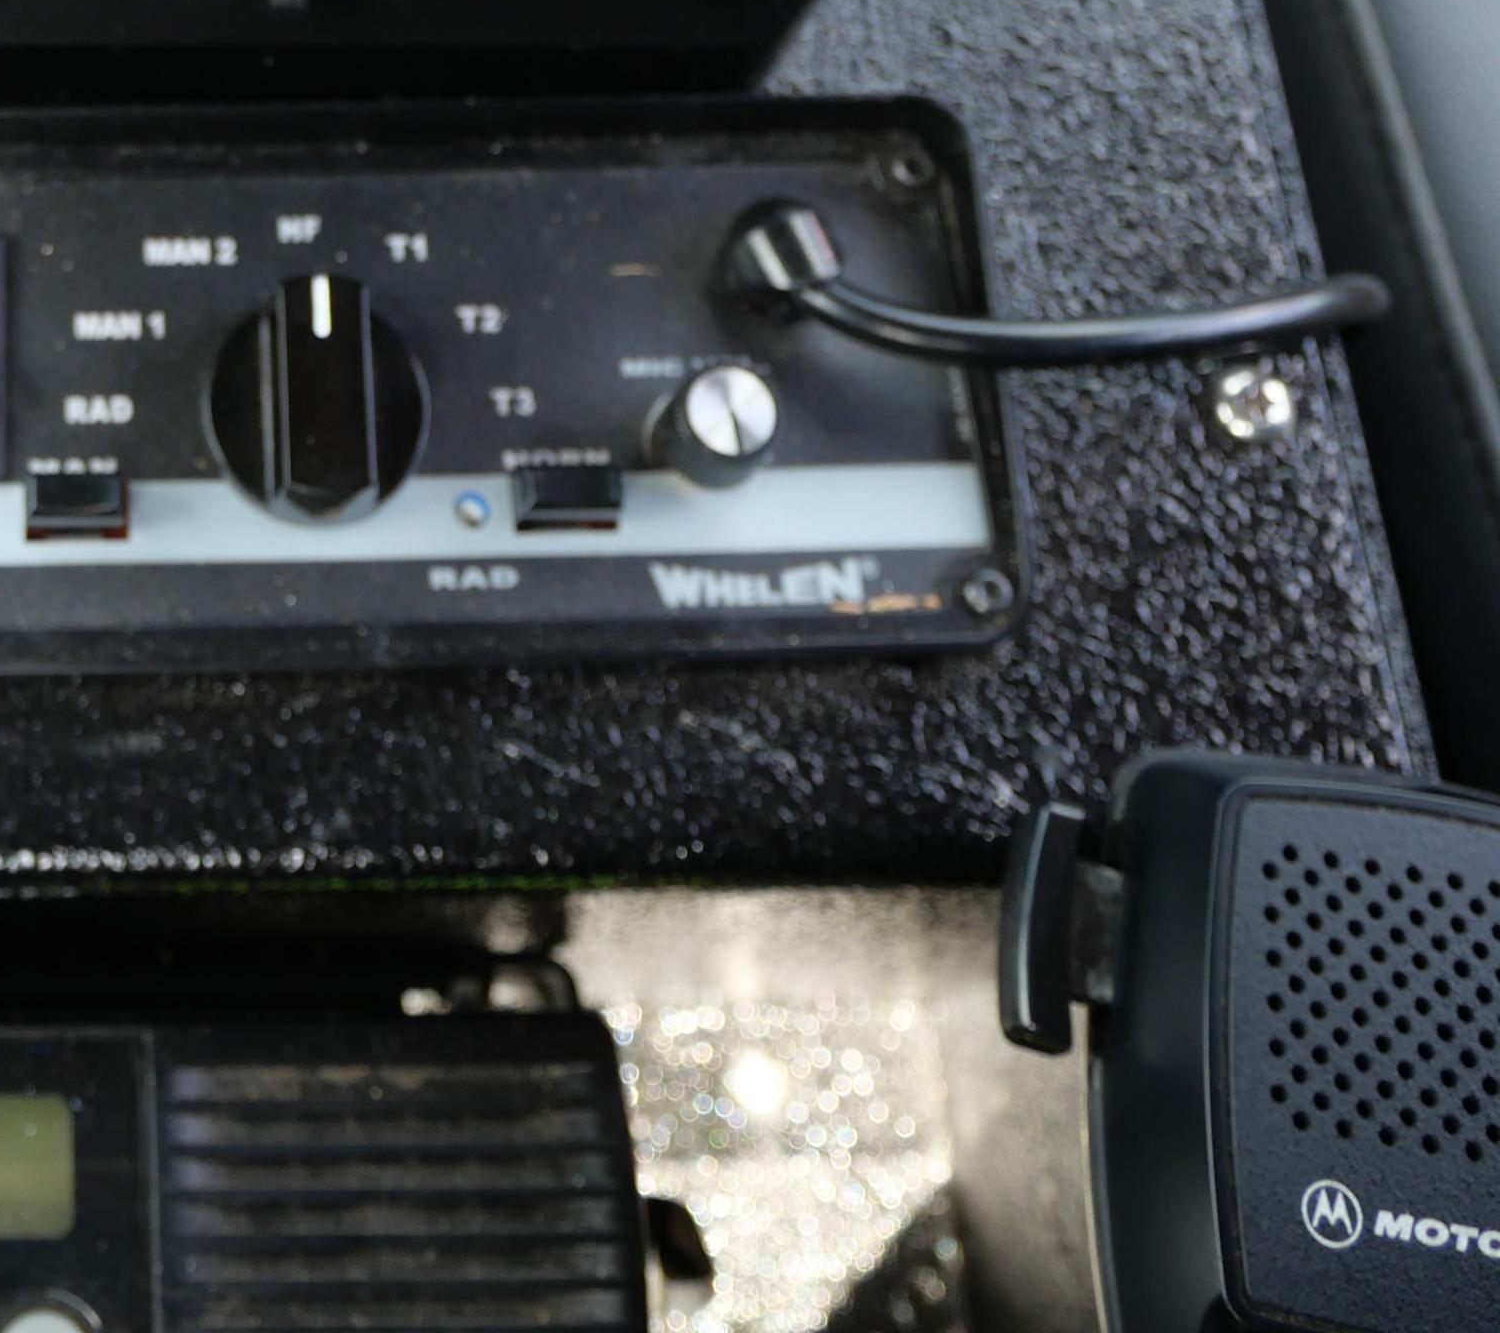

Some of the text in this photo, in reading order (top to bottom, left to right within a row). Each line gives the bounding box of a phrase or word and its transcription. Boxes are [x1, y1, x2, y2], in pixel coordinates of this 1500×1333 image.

[142, 236, 239, 266] MAN 2
[384, 232, 429, 263] T1
[72, 310, 166, 341] MAN 1
[454, 303, 503, 335] T2
[63, 393, 135, 425] RAD
[488, 386, 537, 417] T3
[427, 564, 521, 591] RAD
[648, 557, 865, 610] WHELEN
